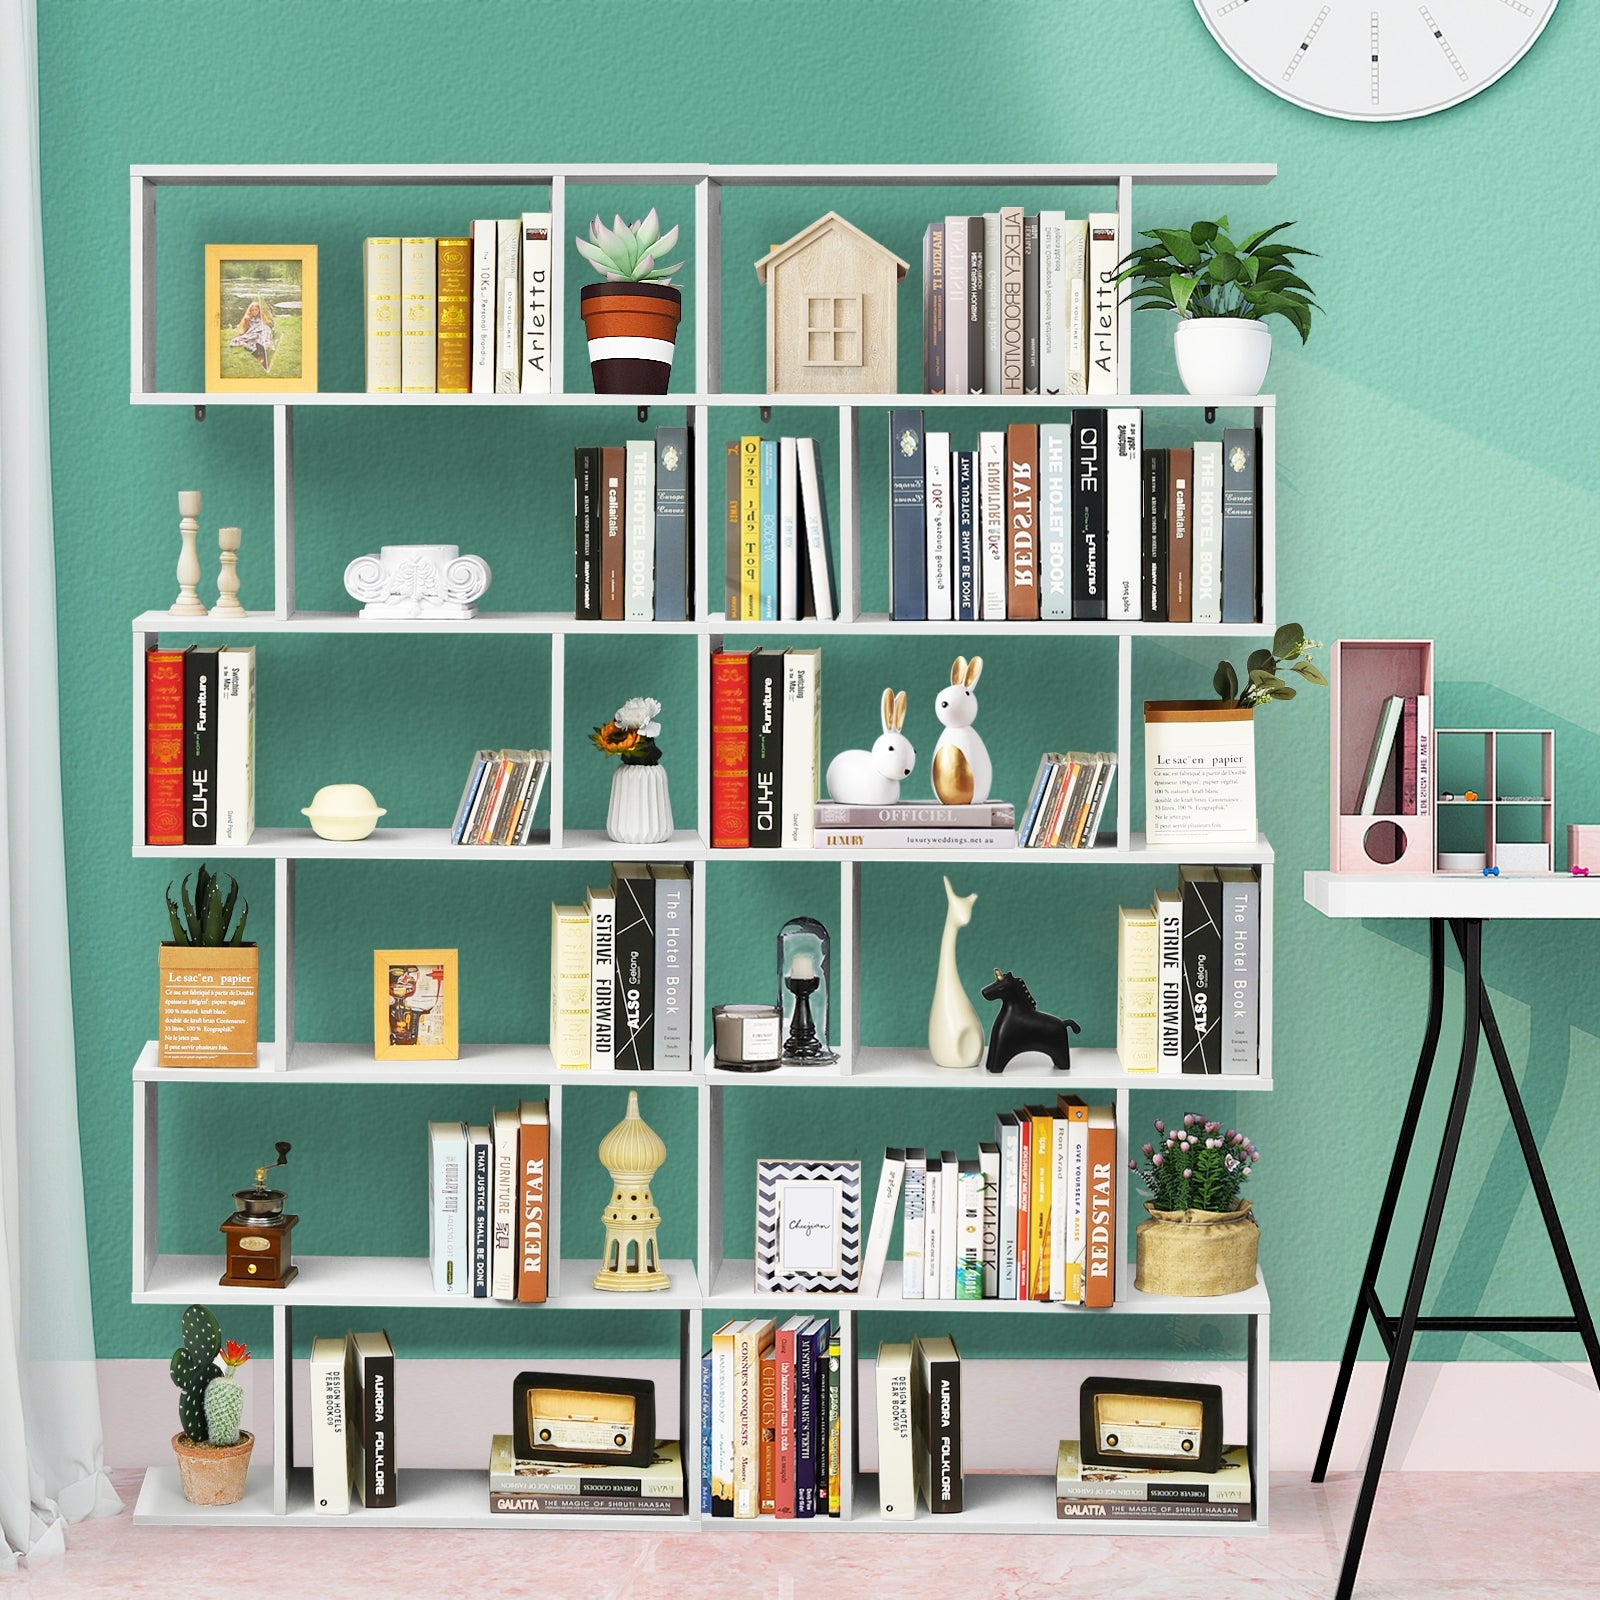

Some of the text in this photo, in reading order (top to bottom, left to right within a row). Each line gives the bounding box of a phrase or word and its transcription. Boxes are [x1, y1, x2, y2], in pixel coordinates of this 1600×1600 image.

[479, 267, 490, 366] 10Ks Personal Branding
[528, 271, 545, 371] Arletta
[1094, 272, 1111, 372] Arletta
[657, 492, 684, 501] Europe
[657, 506, 684, 514] Canvas
[1225, 493, 1252, 502] Europe
[1225, 507, 1252, 515] Canvas
[632, 452, 646, 598] THE HOTEL BOOK
[1199, 453, 1214, 600] THE HOTEL BOOK
[231, 668, 239, 696] Switching
[796, 670, 805, 698] Switching
[197, 675, 207, 731] Furniture
[762, 678, 773, 733] Furniture
[1158, 755, 1170, 764] Le
[1212, 755, 1243, 766] papier
[879, 809, 957, 822] OFFICIEL
[827, 836, 864, 845] LUXURY
[666, 891, 680, 1014] The Hotel Book
[1234, 894, 1248, 1018] The Hotel Book
[169, 972, 181, 982] Le
[221, 974, 252, 985] papier
[596, 914, 612, 1052] STRIVE FORWARD
[1163, 917, 1179, 1056] STRIVE FORWARD
[628, 989, 640, 1029] ALSO
[1194, 993, 1208, 1034] ALSO
[1057, 1128, 1065, 1150] Ron
[499, 1156, 510, 1214] FURNITURE
[1006, 1136, 1016, 1207] STEAM
[1057, 1154, 1065, 1179] Arad
[441, 1163, 459, 1212] Anna Karenina
[477, 1175, 485, 1211] JUSTICE
[524, 1158, 544, 1273] REDSTAR
[1091, 1163, 1110, 1278] REDSTAR
[477, 1248, 484, 1259] BE
[325, 1371, 333, 1392] YEAR
[333, 1372, 341, 1400] DESIGN
[762, 1367, 775, 1424] CHOICES
[802, 1340, 810, 1459] MYSTERY AT SHARK'S TEETH
[891, 1377, 899, 1397] YEAR
[375, 1375, 384, 1495] AURORA FOLKLORE
[941, 1380, 950, 1500] AURORA FOLKLORE
[497, 1499, 539, 1510] GALATTA
[1064, 1505, 1106, 1516] GALATTA
